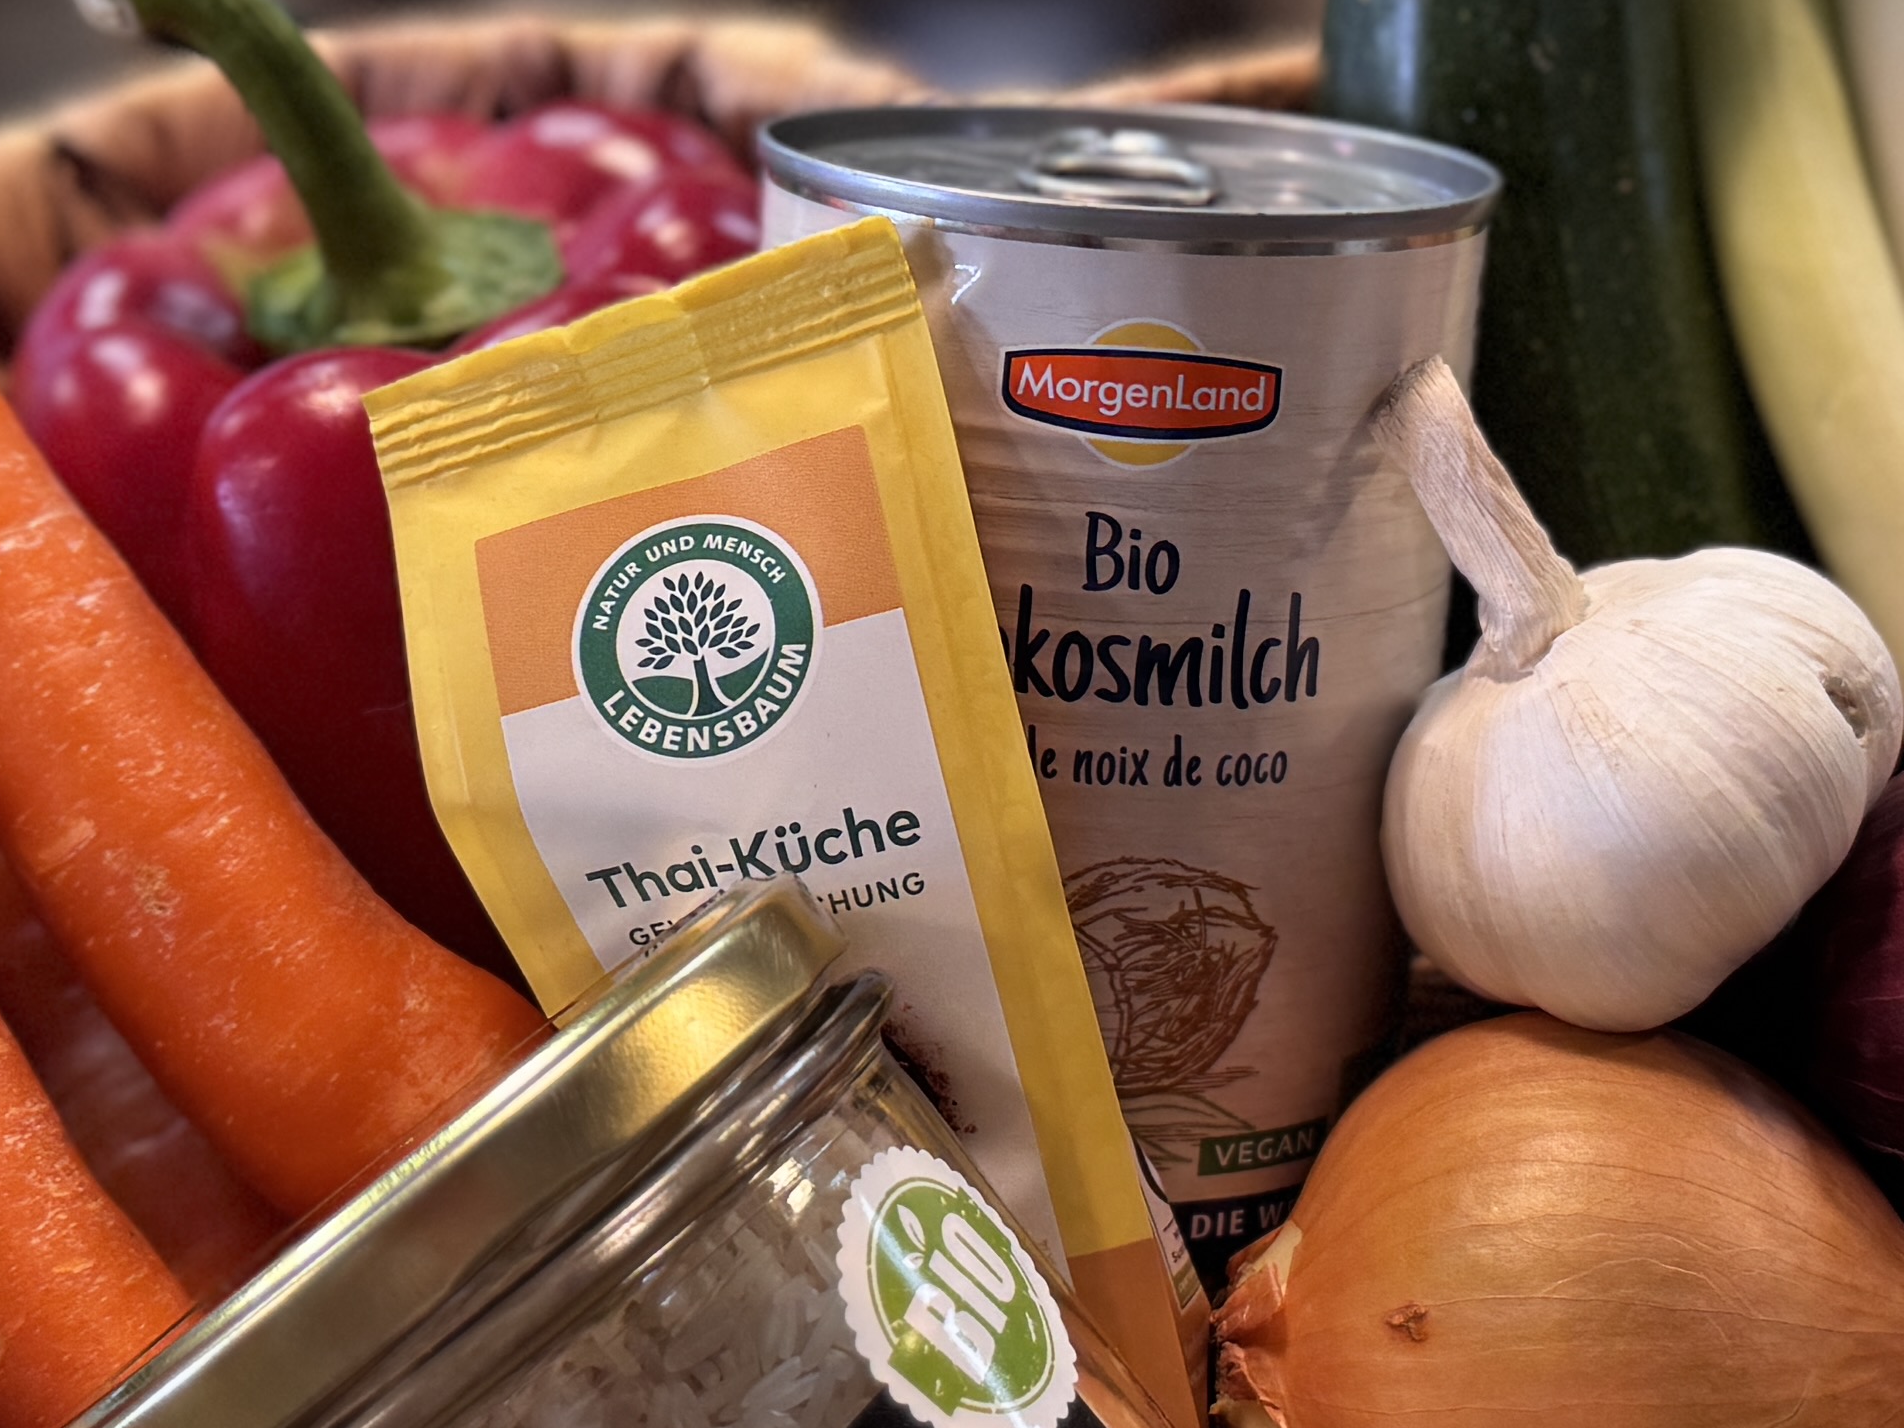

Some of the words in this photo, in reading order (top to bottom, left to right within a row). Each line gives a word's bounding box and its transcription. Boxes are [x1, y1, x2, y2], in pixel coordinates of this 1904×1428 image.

[1016, 361, 1266, 416] MorgenLand
[592, 561, 642, 630] NATUR
[645, 535, 695, 563] UND
[703, 534, 787, 584] MENSCH
[1082, 511, 1180, 595] Bio
[998, 583, 1319, 710] kosmilch
[602, 643, 807, 752] LEBENSBAUM
[1073, 746, 1149, 787] noix
[1163, 734, 1202, 787] de
[1216, 748, 1287, 785] coco
[585, 806, 922, 909] Thai-Küche
[1215, 1127, 1316, 1167] VEGAN
[1191, 1209, 1244, 1239] DIE
[904, 1212, 1016, 1385] BIO
